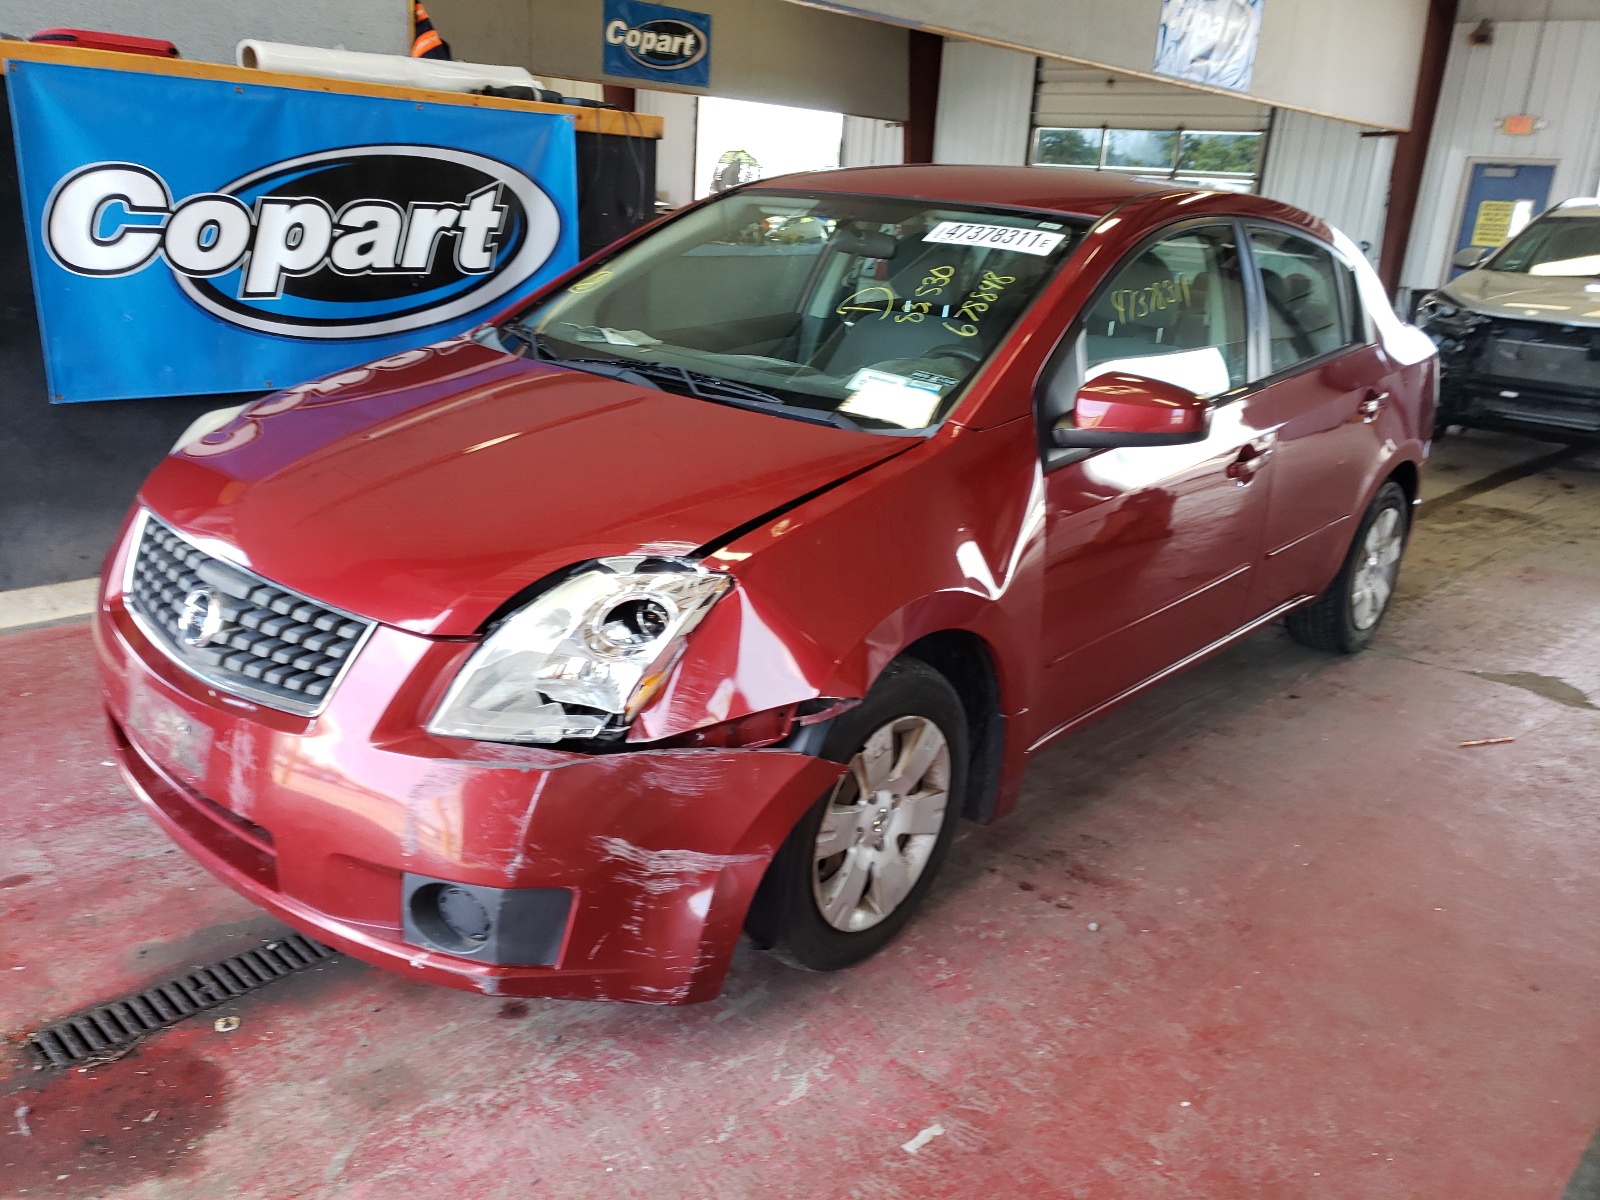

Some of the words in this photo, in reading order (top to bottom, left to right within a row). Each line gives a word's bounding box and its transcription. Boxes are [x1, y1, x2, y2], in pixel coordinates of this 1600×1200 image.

[605, 19, 696, 56] Copart
[43, 161, 508, 300] Copart
[944, 224, 1044, 247] 47378311
